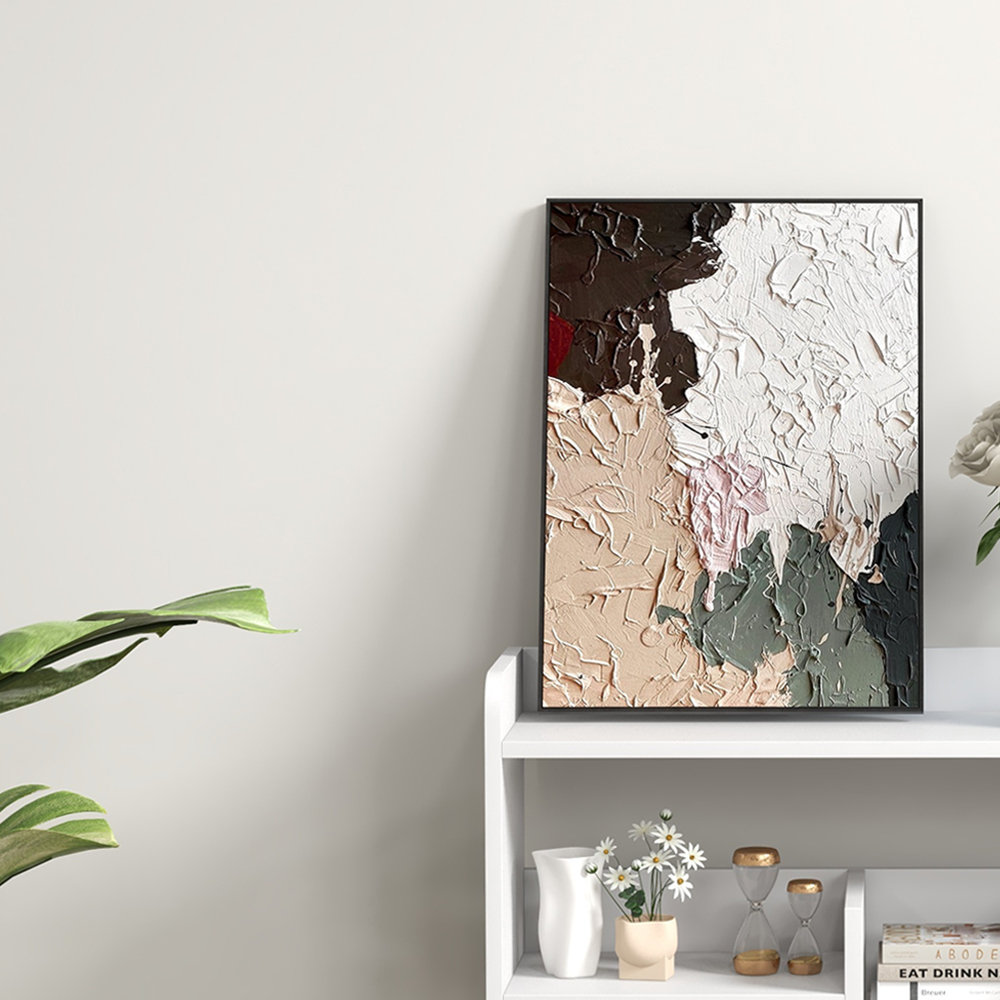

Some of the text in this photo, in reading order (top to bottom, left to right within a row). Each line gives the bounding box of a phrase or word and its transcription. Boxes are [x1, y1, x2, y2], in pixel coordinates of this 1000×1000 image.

[935, 949, 998, 960] ABODE
[899, 968, 928, 978] EAT
[933, 968, 983, 978] DRINK
